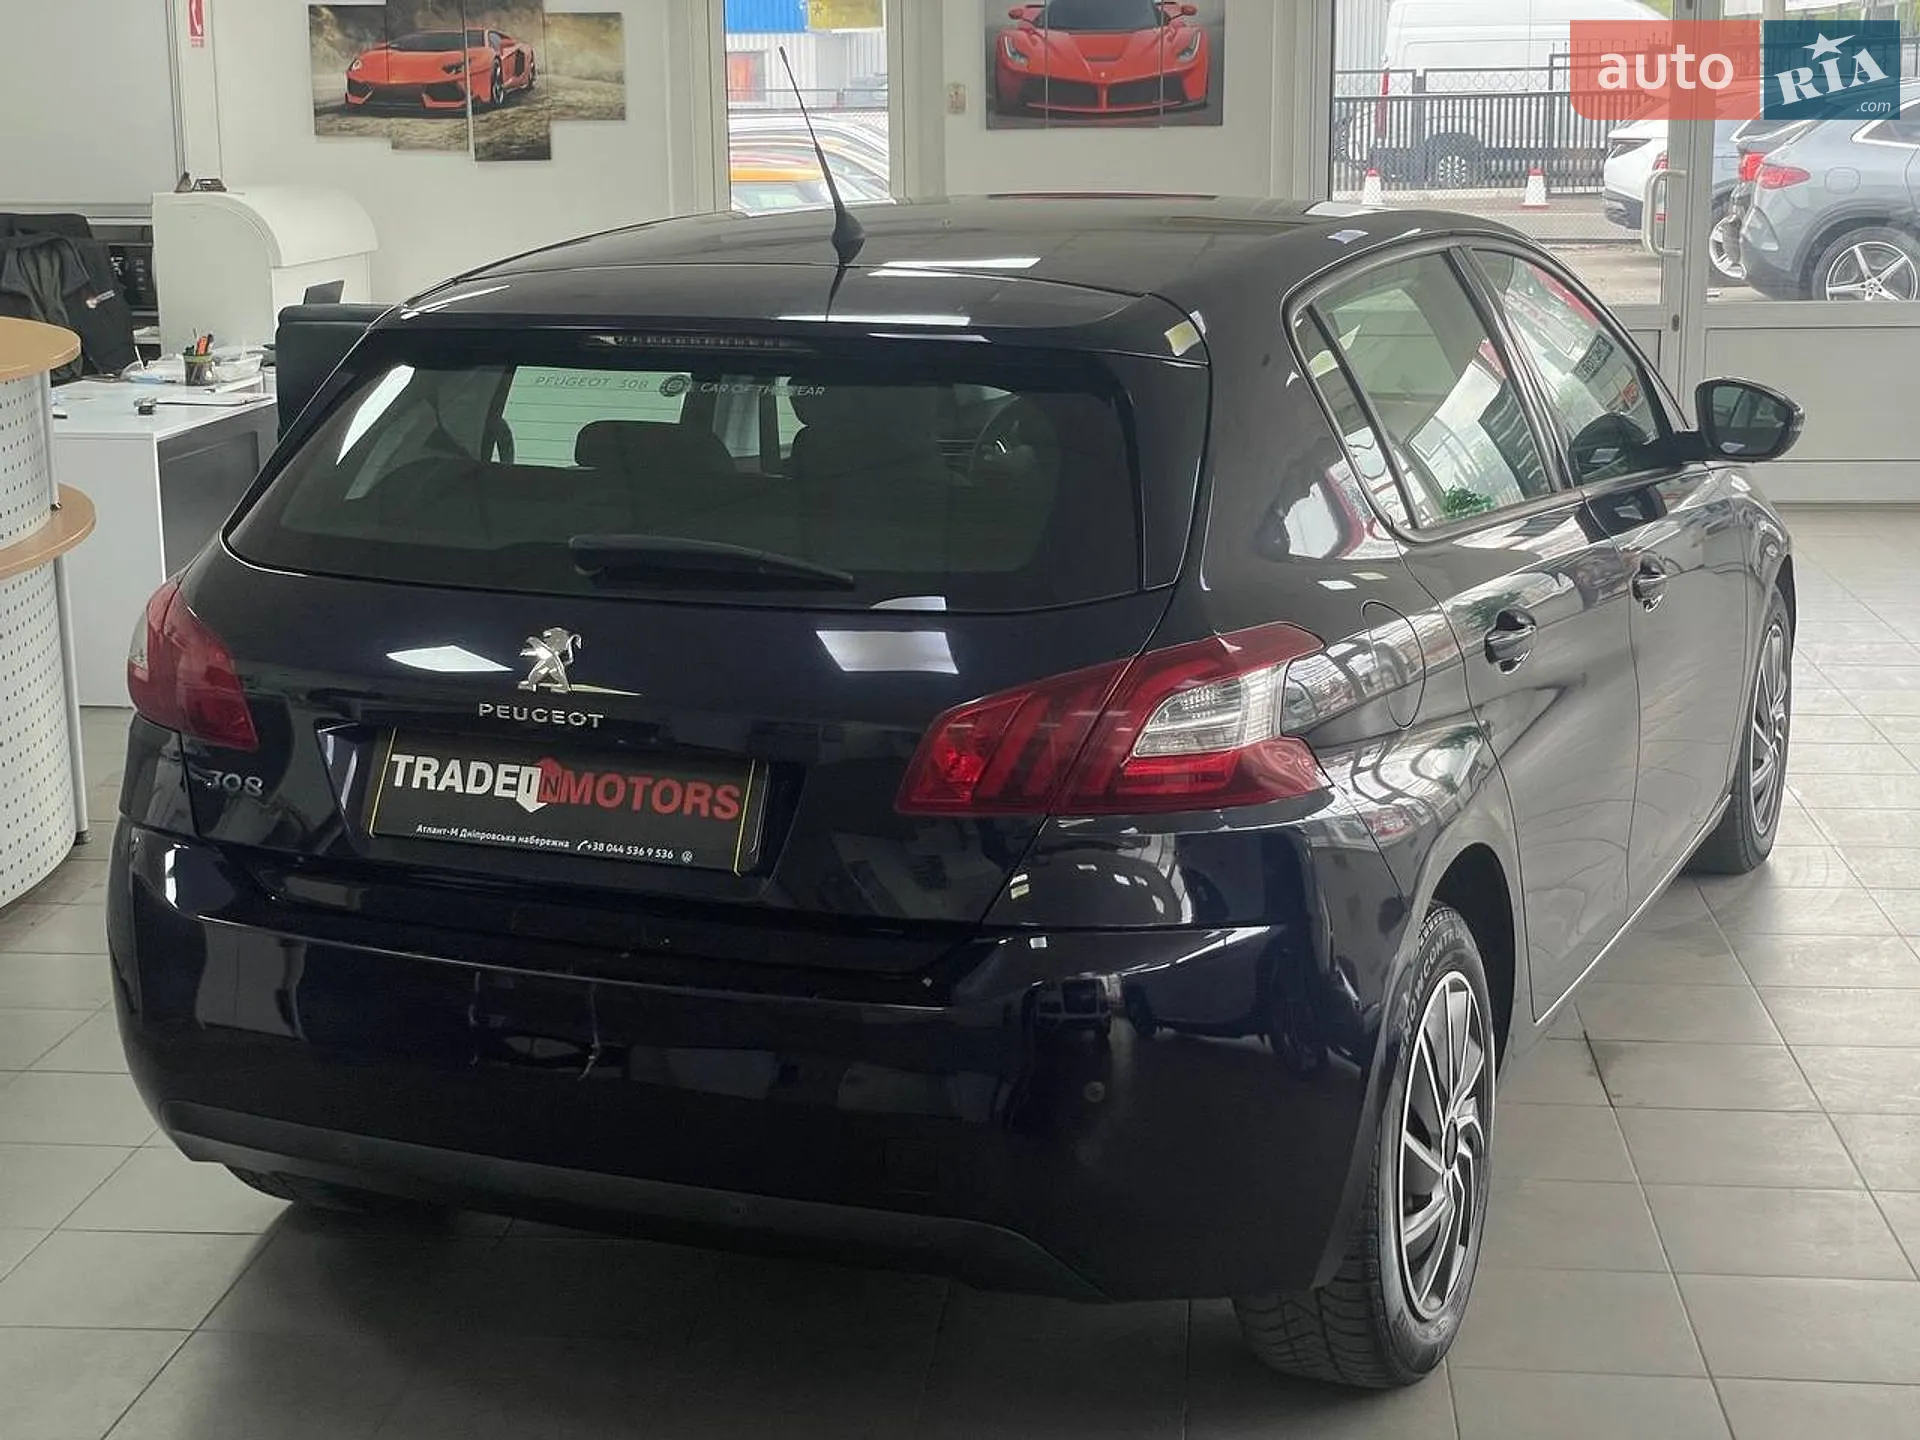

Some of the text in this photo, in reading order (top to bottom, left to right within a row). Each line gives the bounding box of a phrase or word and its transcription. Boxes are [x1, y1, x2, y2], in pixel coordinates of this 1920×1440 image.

[535, 376, 611, 388] PEUGEOT
[700, 382, 729, 394] CAR
[731, 384, 755, 394] OF
[479, 703, 604, 728] PEUGEOT
[416, 823, 459, 837] Атлант-М
[459, 828, 517, 843] Дніпровська
[518, 835, 570, 848] набережна
[606, 843, 624, 854] 044
[626, 845, 645, 856] 536
[655, 848, 674, 860] 536
